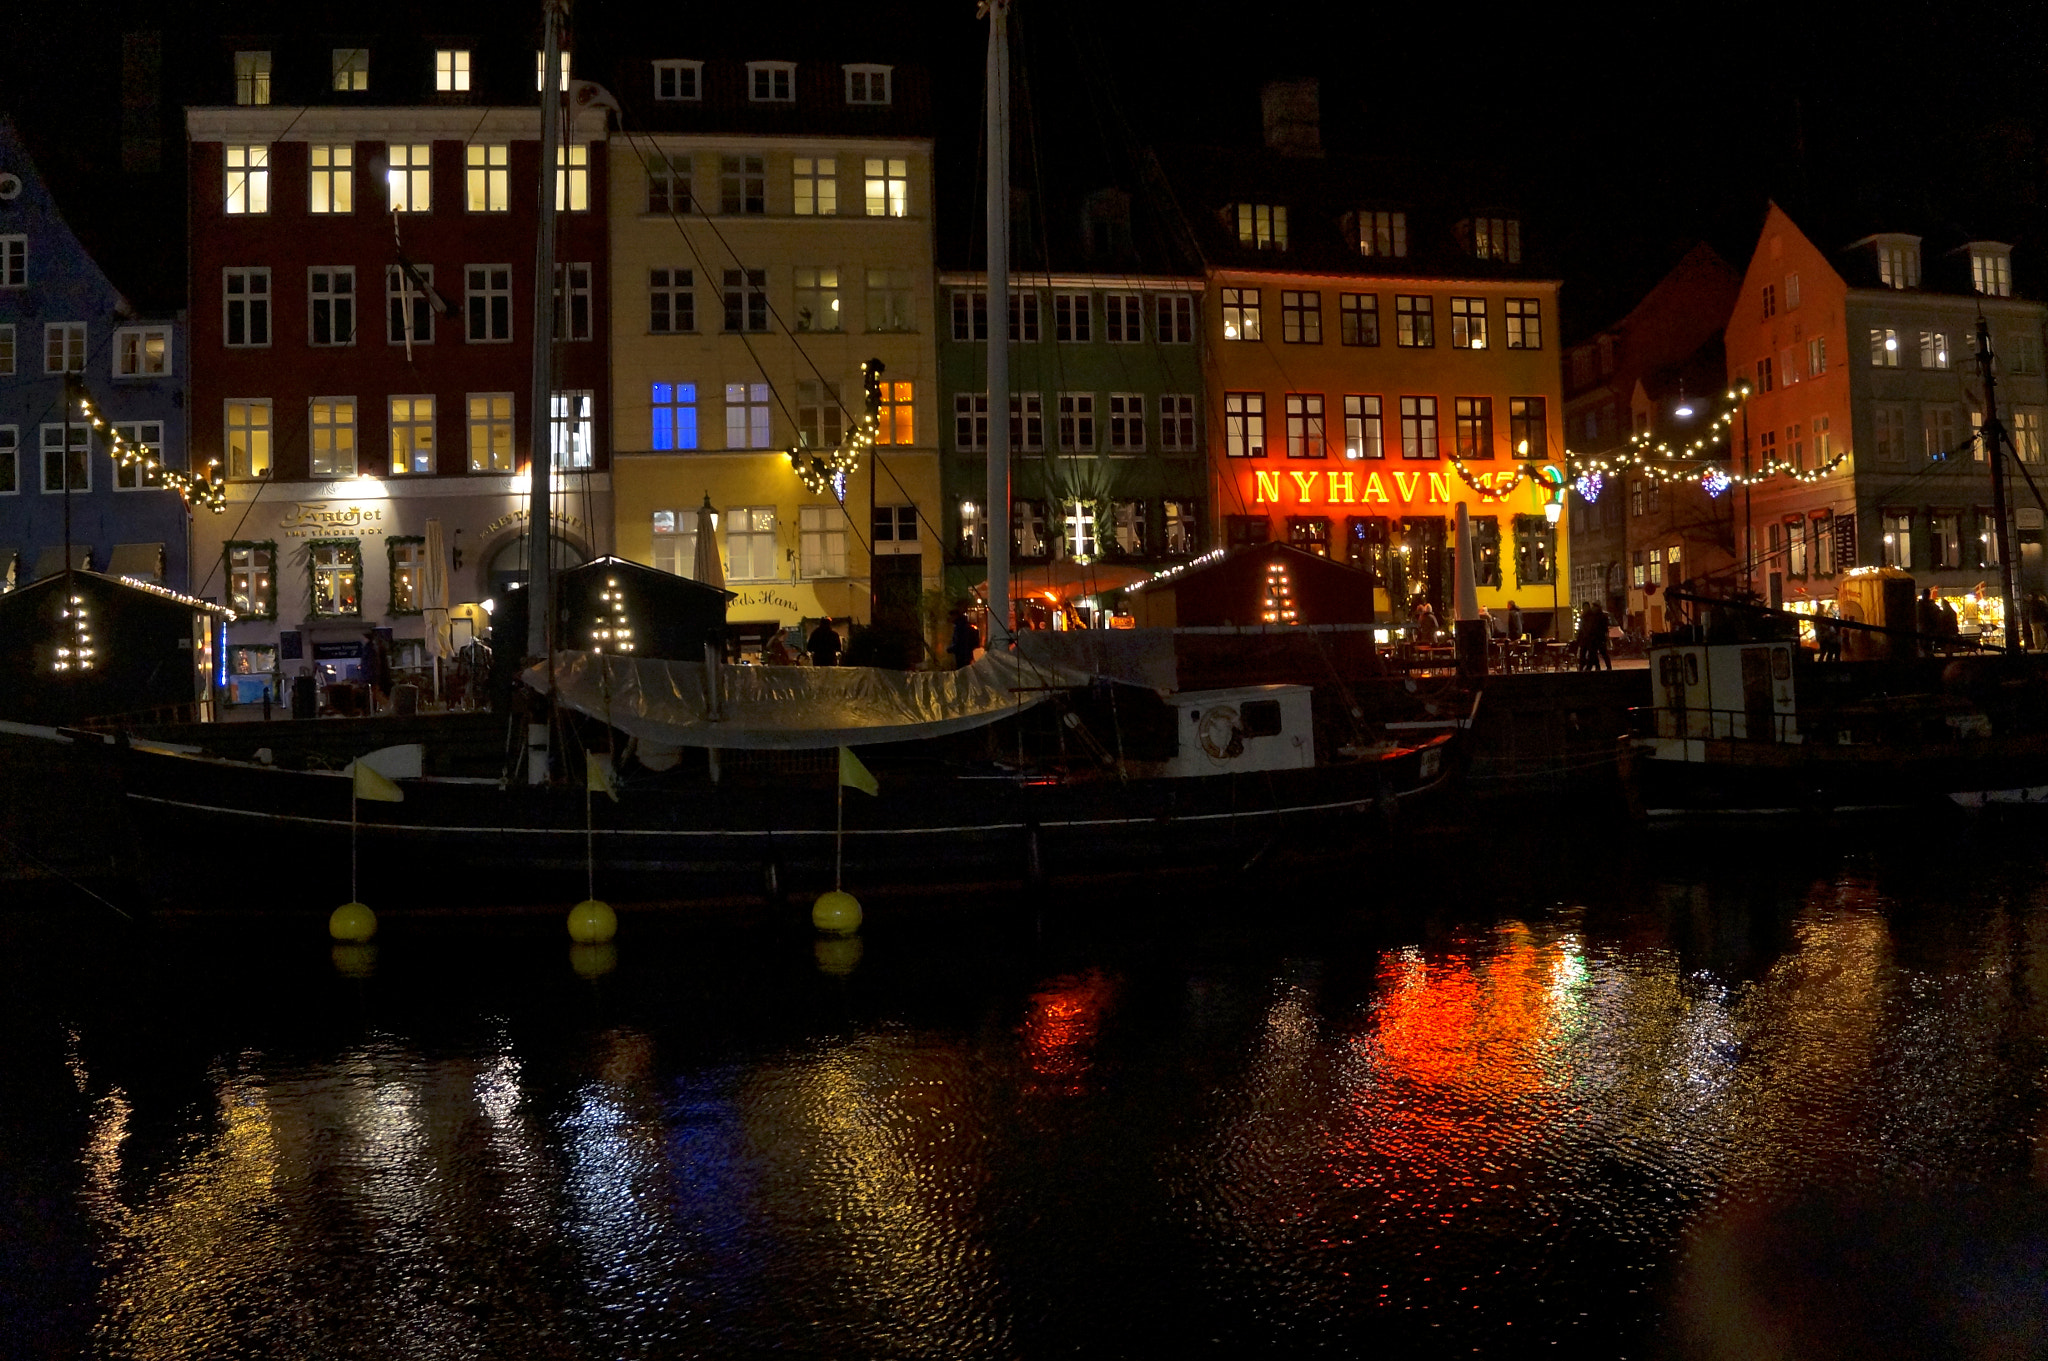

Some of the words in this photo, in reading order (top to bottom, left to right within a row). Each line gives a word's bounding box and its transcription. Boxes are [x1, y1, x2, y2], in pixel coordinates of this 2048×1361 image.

[1255, 471, 1451, 502] NYHAVN
[1479, 471, 1516, 503] 17
[360, 528, 383, 536] BOX
[727, 591, 754, 608] ods
[758, 589, 799, 612] Hans
